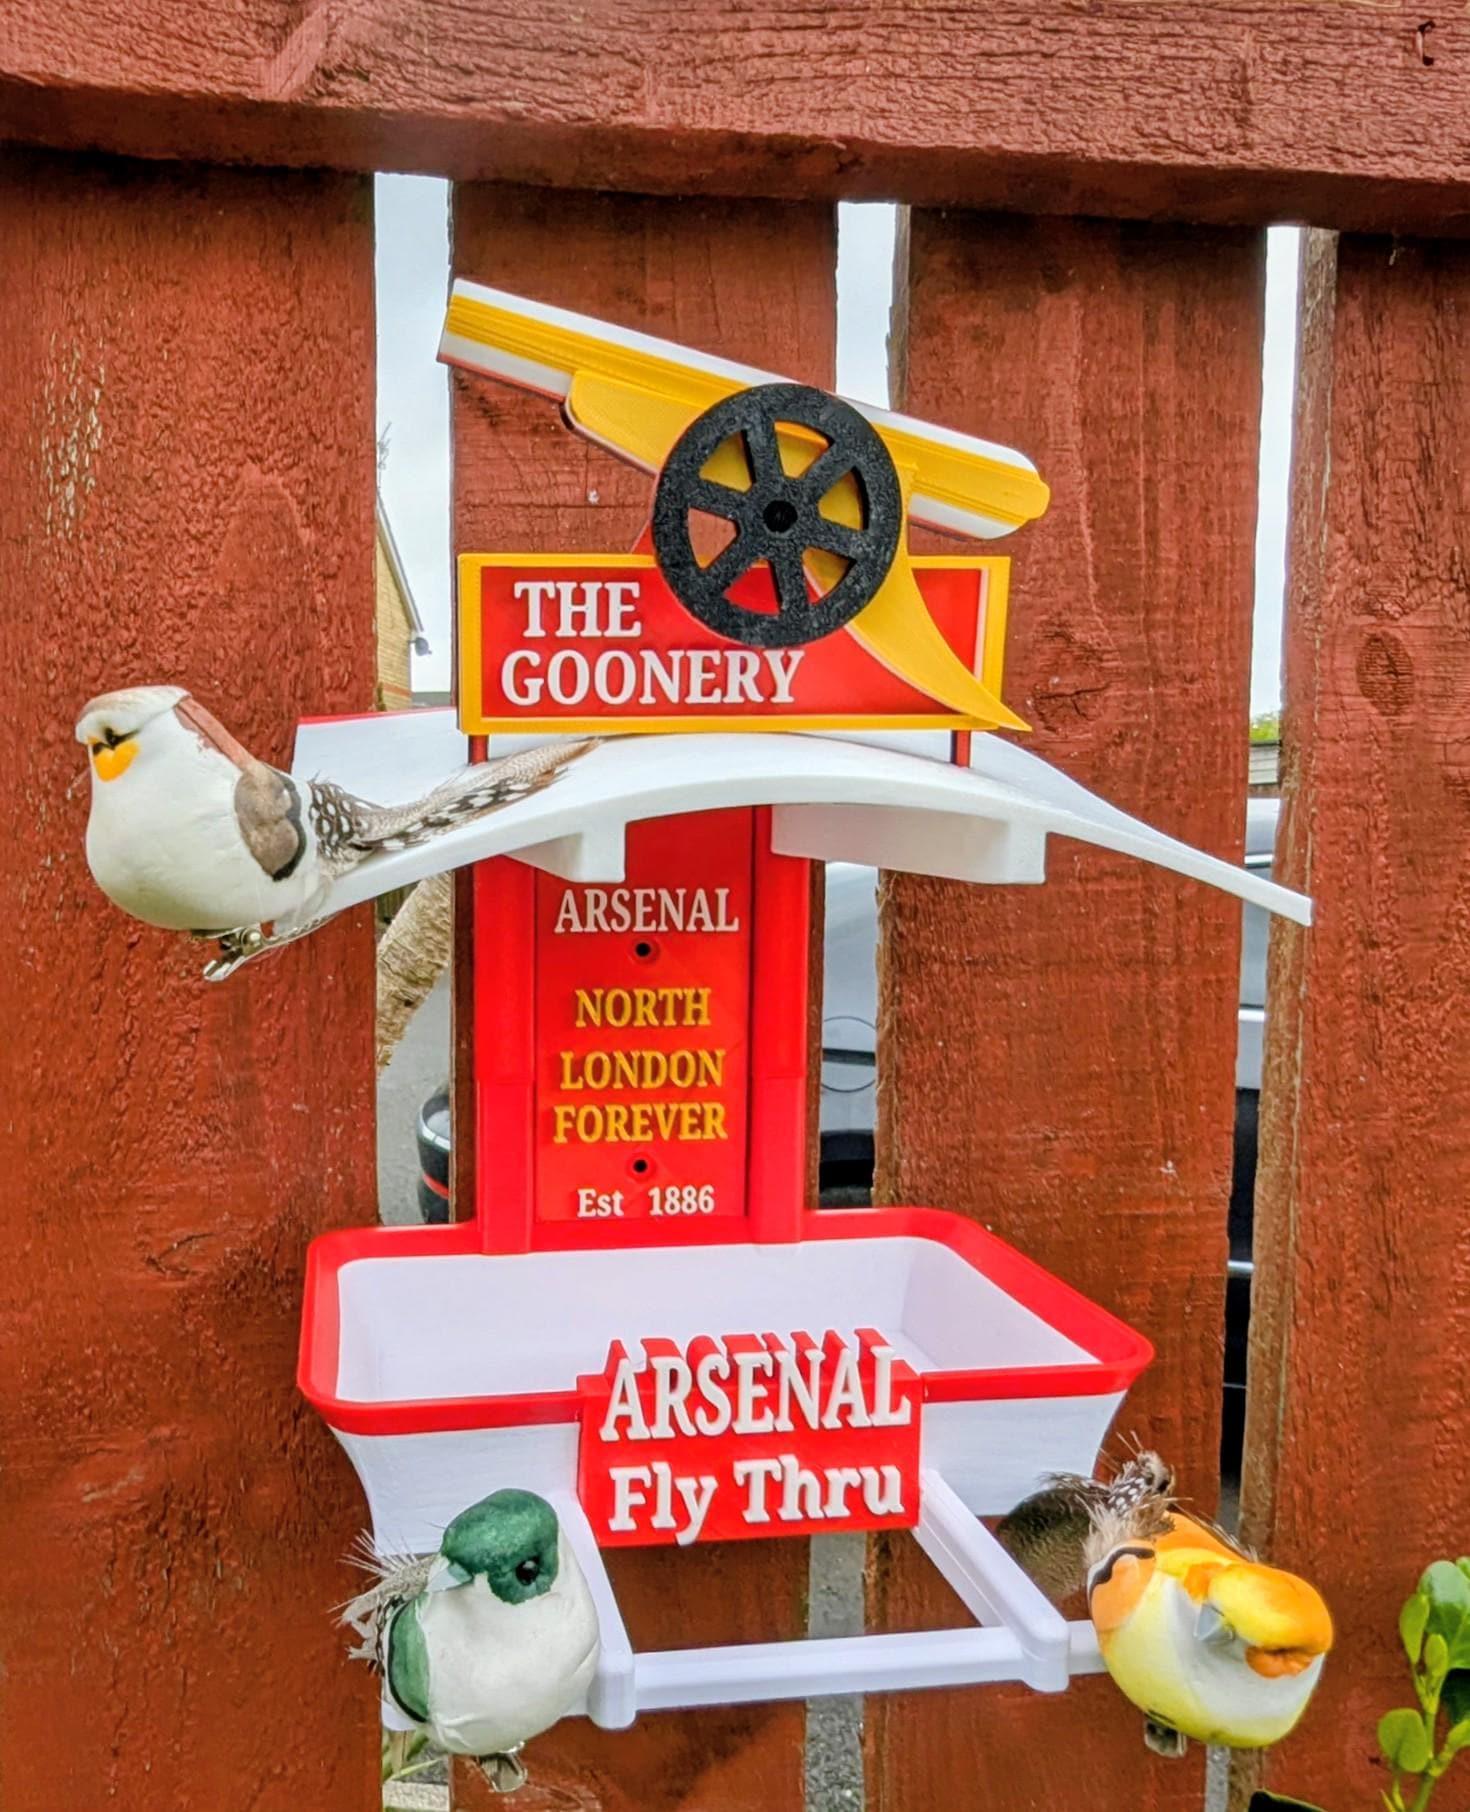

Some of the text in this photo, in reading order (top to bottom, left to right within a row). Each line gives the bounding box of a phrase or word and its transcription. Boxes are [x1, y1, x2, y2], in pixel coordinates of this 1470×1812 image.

[513, 581, 642, 638] THE
[501, 649, 804, 706] GOONERY
[554, 888, 740, 933] ARSENAL
[575, 987, 712, 1028] NORTH
[560, 1049, 726, 1090] LONDON
[553, 1102, 728, 1144] FOREVER
[577, 1185, 715, 1217] Est 1886
[600, 1346, 911, 1441] ARSENAL
[608, 1454, 905, 1546] Fly Thru
